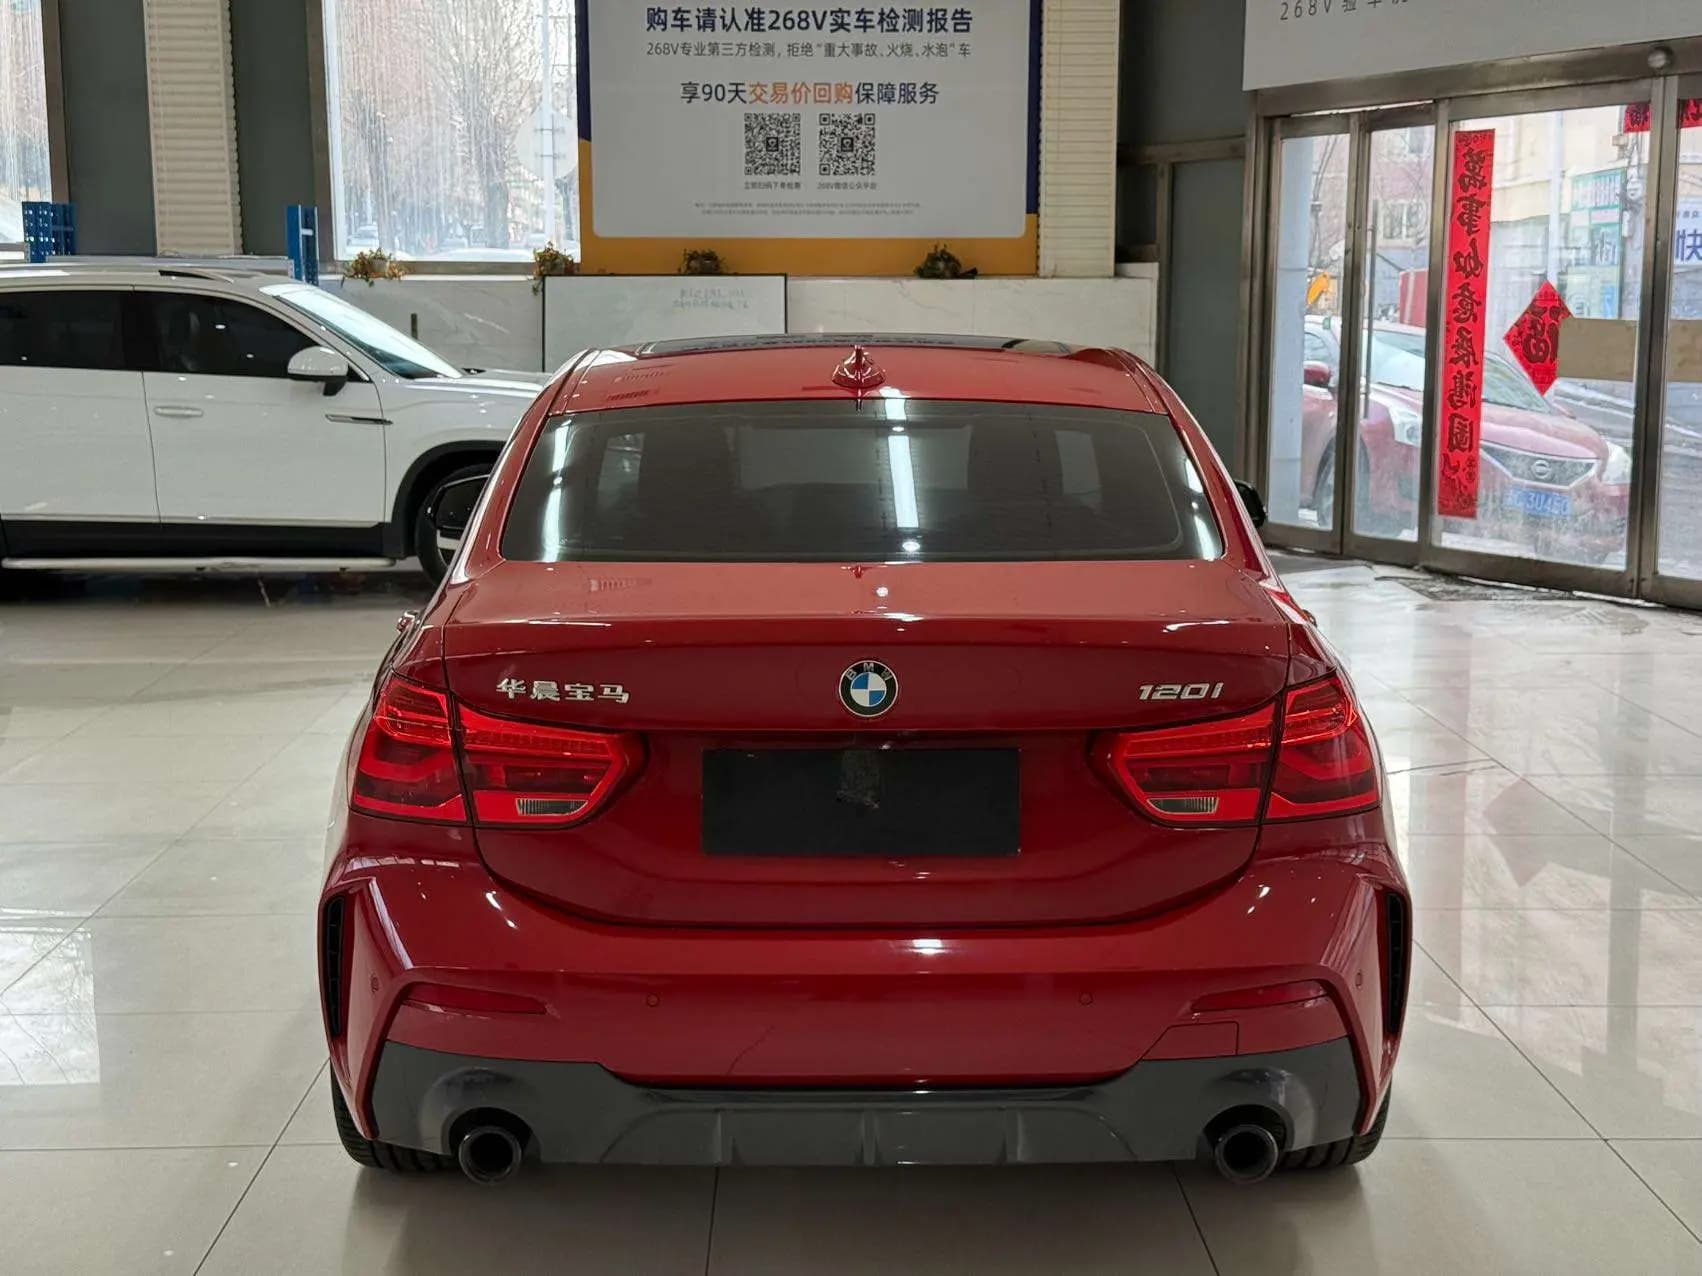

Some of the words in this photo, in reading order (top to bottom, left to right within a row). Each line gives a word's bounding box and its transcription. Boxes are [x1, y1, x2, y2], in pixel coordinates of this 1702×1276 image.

[646, 7, 973, 33] 购车请认准268V实车检测报告
[680, 81, 940, 105] 享90天交易价回购保障服务
[845, 662, 893, 681] BMW
[496, 678, 630, 704] 华晨宝马
